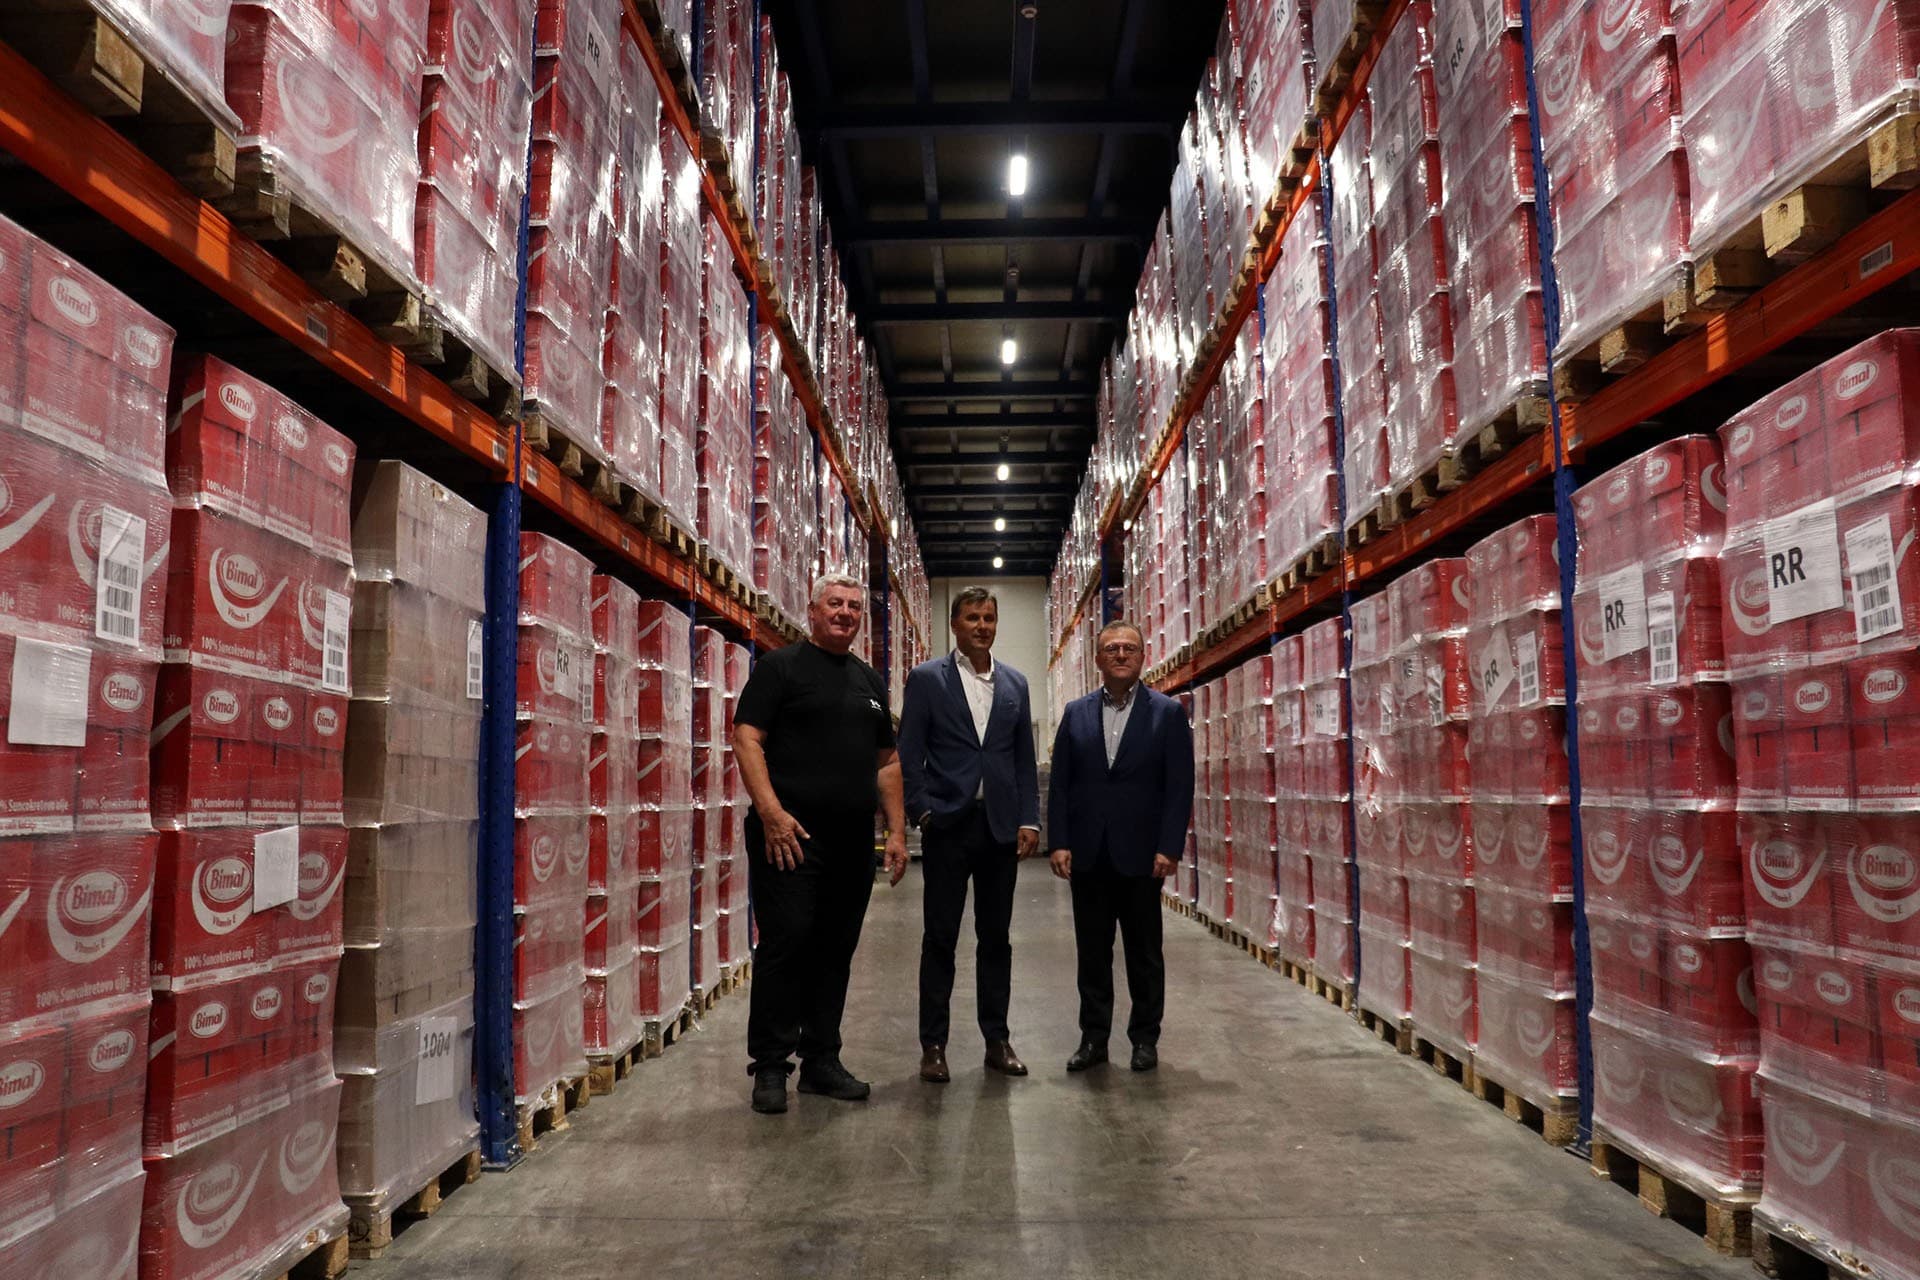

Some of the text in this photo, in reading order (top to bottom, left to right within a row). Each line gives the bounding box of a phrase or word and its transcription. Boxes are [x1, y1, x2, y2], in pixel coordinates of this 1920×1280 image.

[588, 32, 600, 68] RR
[1450, 38, 1464, 73] RR
[56, 282, 92, 318] Bimal
[129, 331, 158, 361] Bimal
[1839, 364, 1870, 394] Bimal
[226, 387, 253, 412] Bimal
[1779, 400, 1802, 423] Bimal
[226, 560, 259, 589] Bimal
[1771, 546, 1806, 588] RR
[227, 607, 246, 623] Vitamin
[1604, 600, 1626, 633] RR
[202, 635, 218, 652] 100%
[557, 649, 569, 675] RR
[1484, 659, 1500, 692] RR
[1867, 675, 1898, 695] Bimal
[109, 680, 140, 701] Bimal
[1800, 687, 1825, 706] Bimal
[209, 696, 236, 715] Bimal
[267, 704, 289, 722] Bimal
[317, 713, 336, 732] Bimal
[1765, 850, 1795, 869] Bimal
[1866, 854, 1907, 878] Bimal
[211, 867, 245, 890] Bimal
[300, 862, 325, 881] Bimal
[72, 881, 117, 910] Bimal
[213, 916, 231, 928] Vitamin
[75, 941, 100, 954] Vitamin
[184, 947, 254, 971] 100% Suncokretovo ulje
[36, 988, 60, 1008] 100%
[61, 979, 114, 1003] Suncokretovo
[308, 982, 327, 997] Bimal
[1819, 977, 1846, 996] Bimal
[256, 993, 279, 1012] Bimal
[1899, 994, 1920, 1013] Bim
[195, 1008, 223, 1030] Bimal
[96, 1036, 129, 1061] Bimal
[423, 1031, 451, 1059] 1004
[0, 1068, 36, 1097] Bimal
[199, 1173, 233, 1200] Bimal
